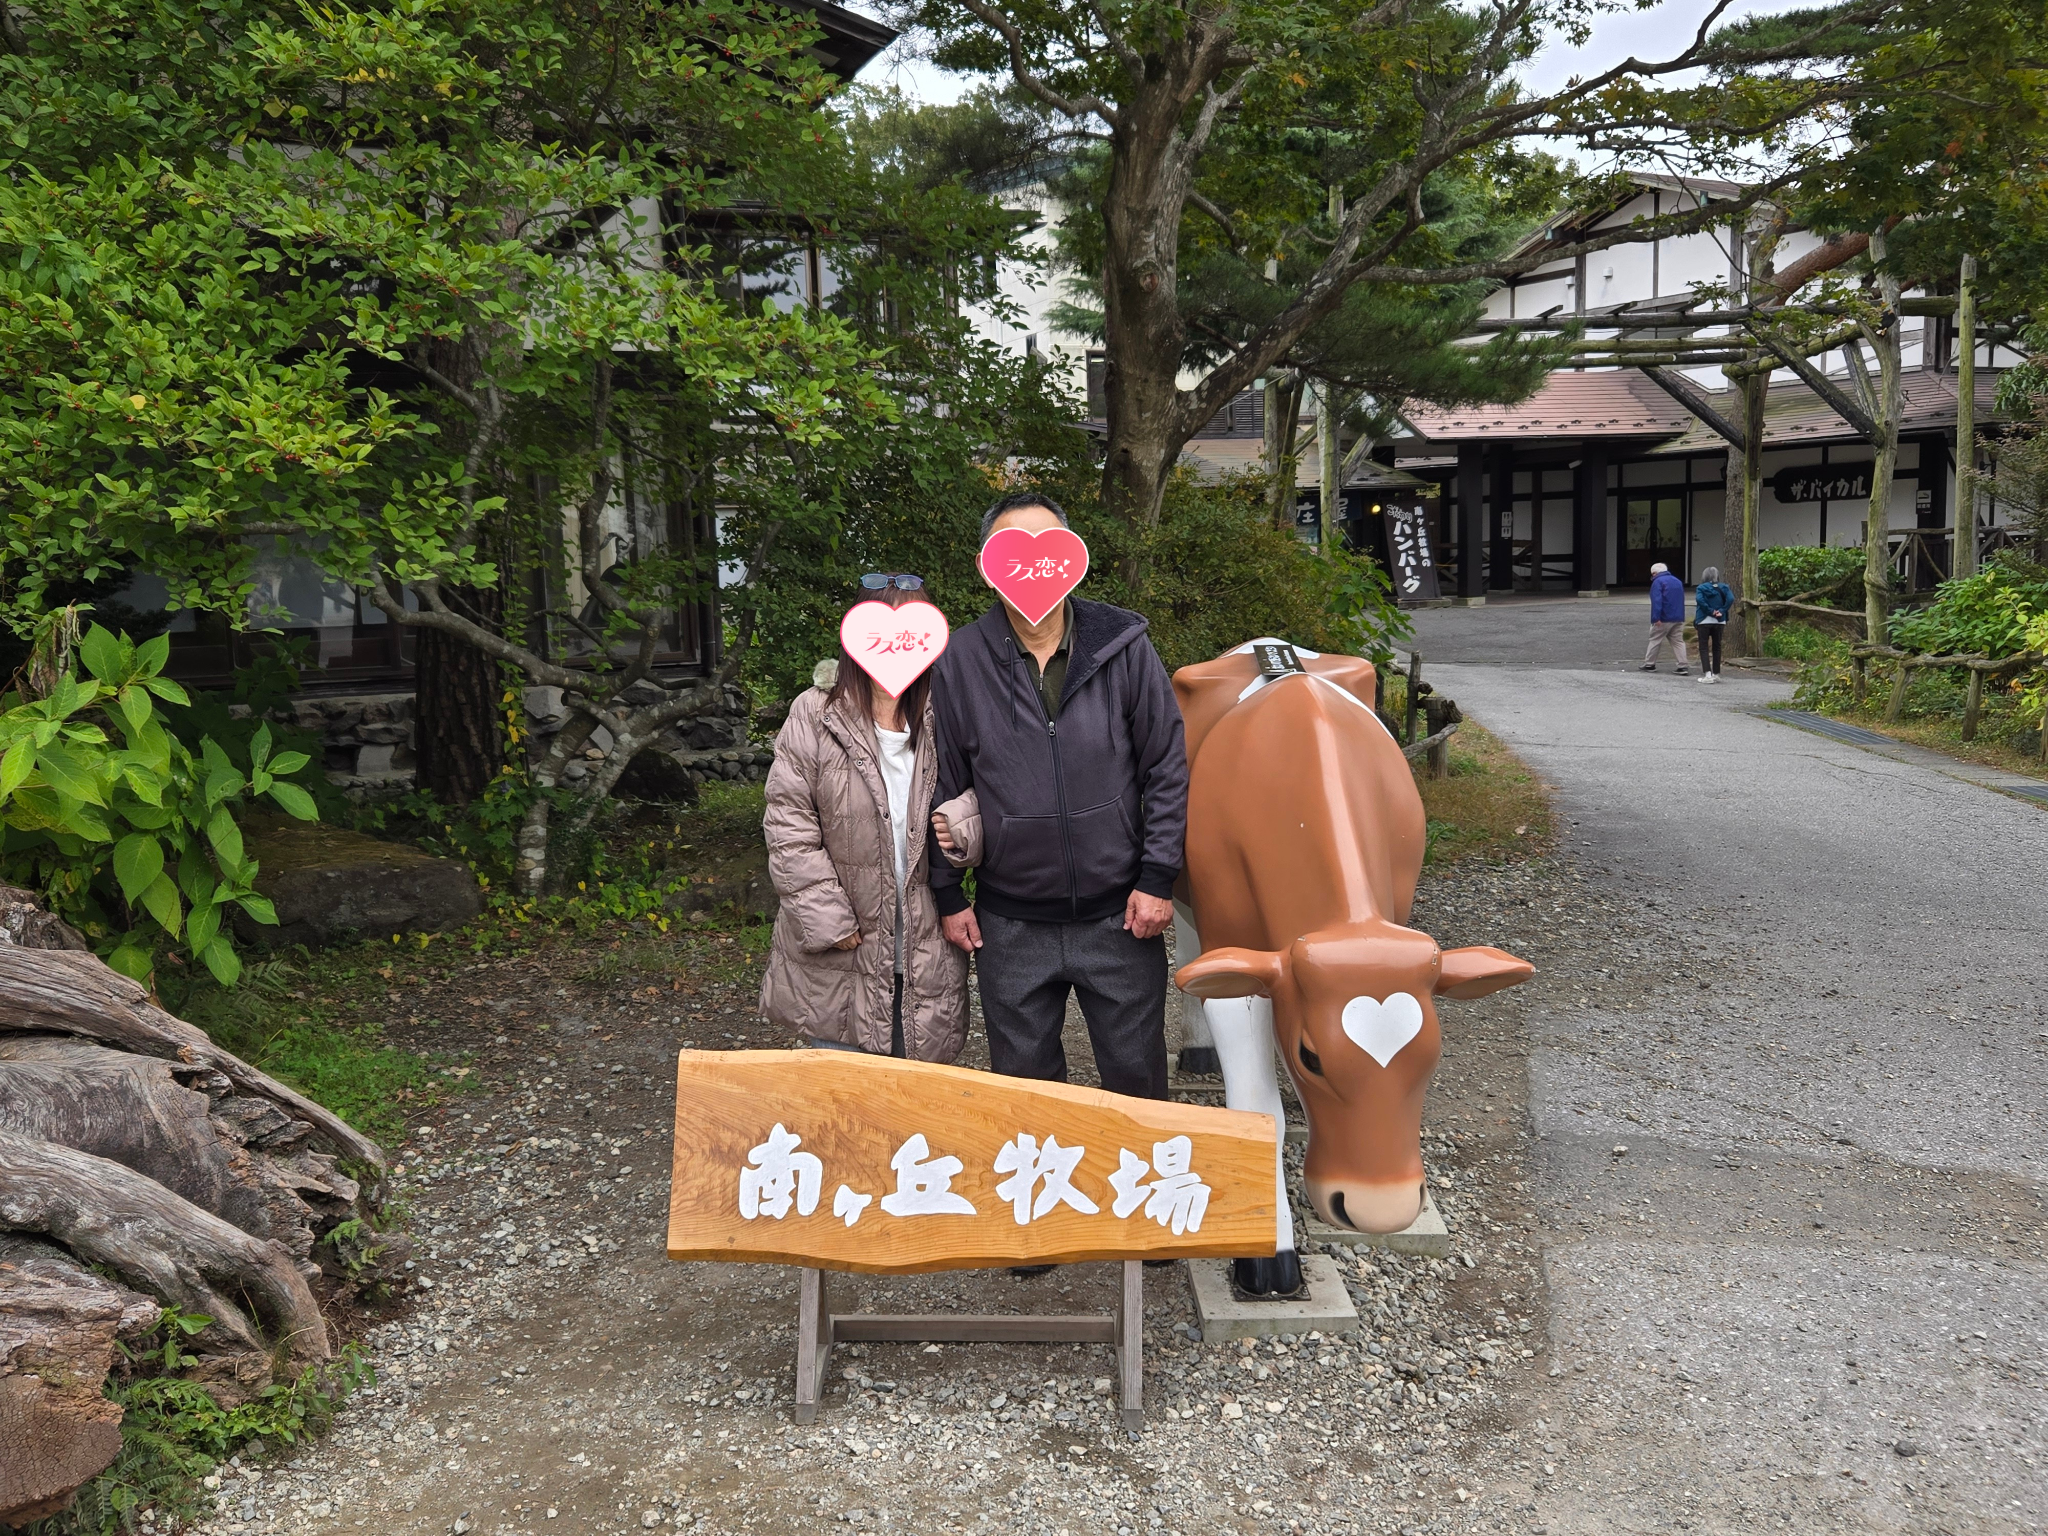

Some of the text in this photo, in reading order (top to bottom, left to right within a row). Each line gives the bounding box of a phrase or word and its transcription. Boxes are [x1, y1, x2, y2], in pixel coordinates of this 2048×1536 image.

[1393, 521, 1421, 594] ハンバーグ
